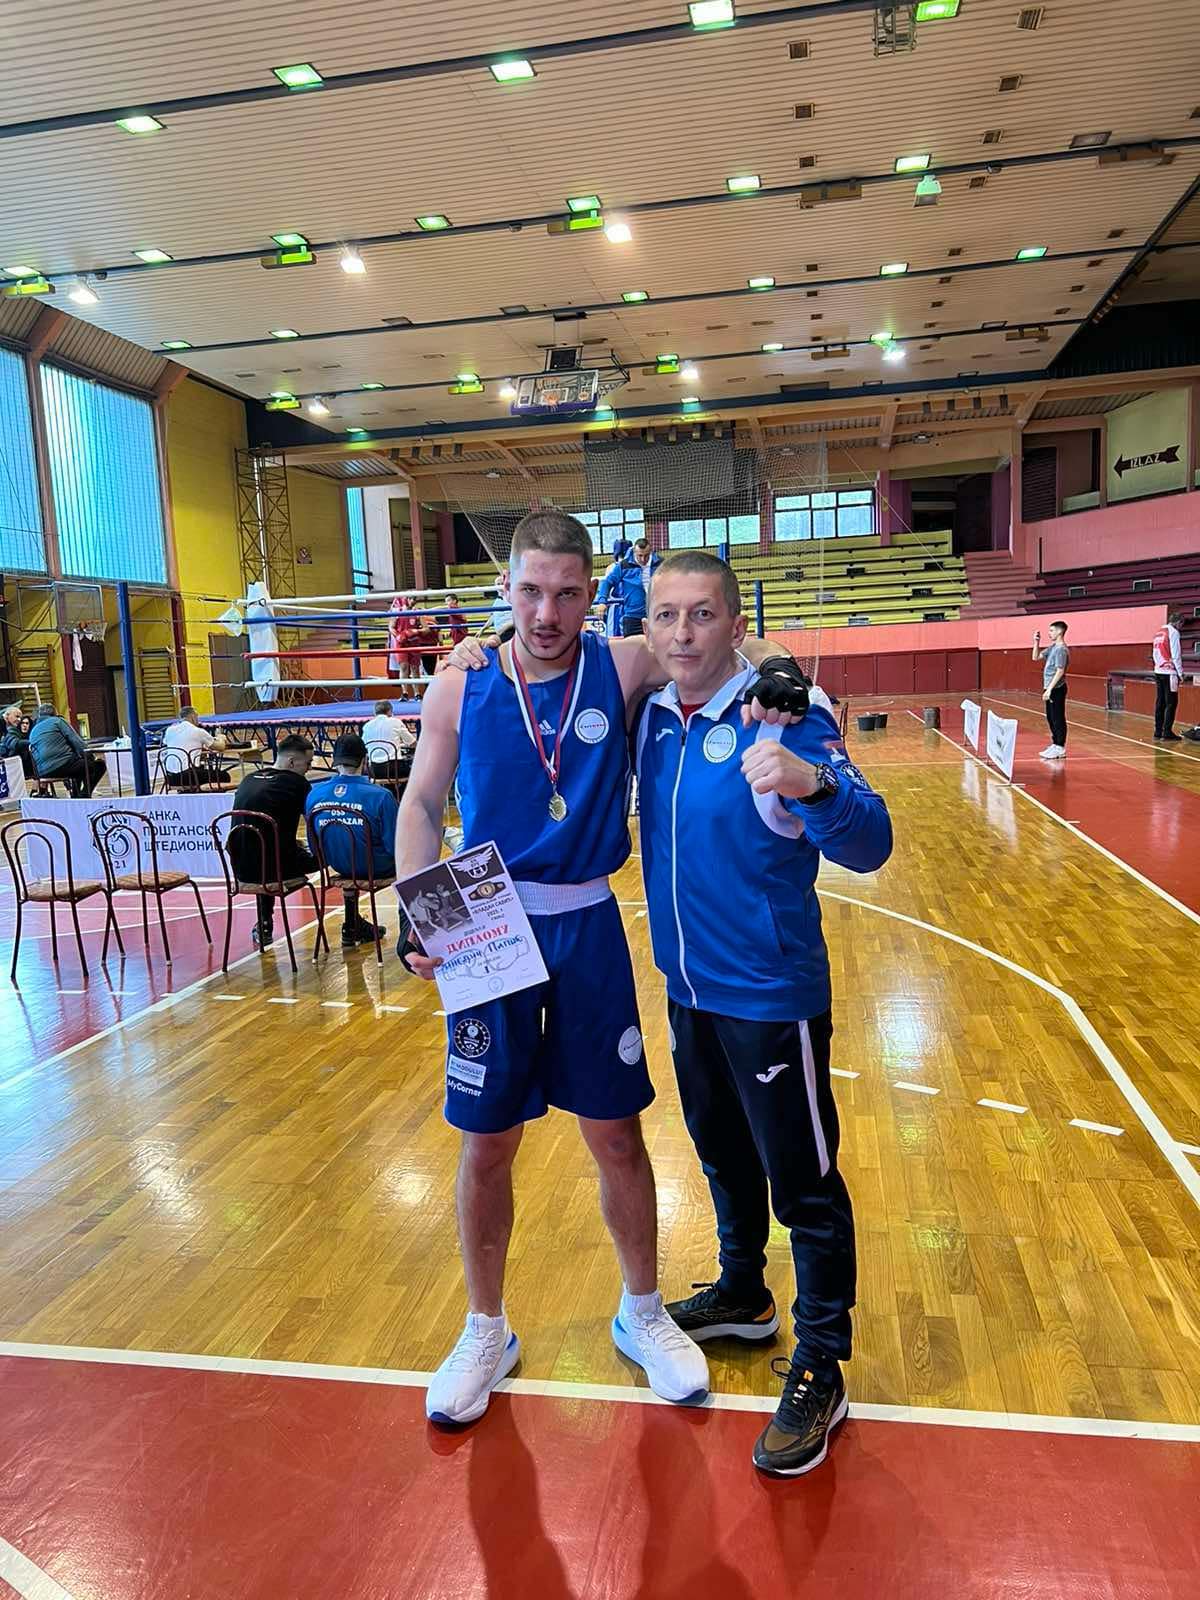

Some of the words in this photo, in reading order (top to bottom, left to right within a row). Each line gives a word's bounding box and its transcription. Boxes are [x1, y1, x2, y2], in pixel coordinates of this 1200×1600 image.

[1130, 453, 1160, 468] IZLAZ
[142, 810, 181, 821] АНКА
[447, 924, 508, 955] ДИПЛОМУ
